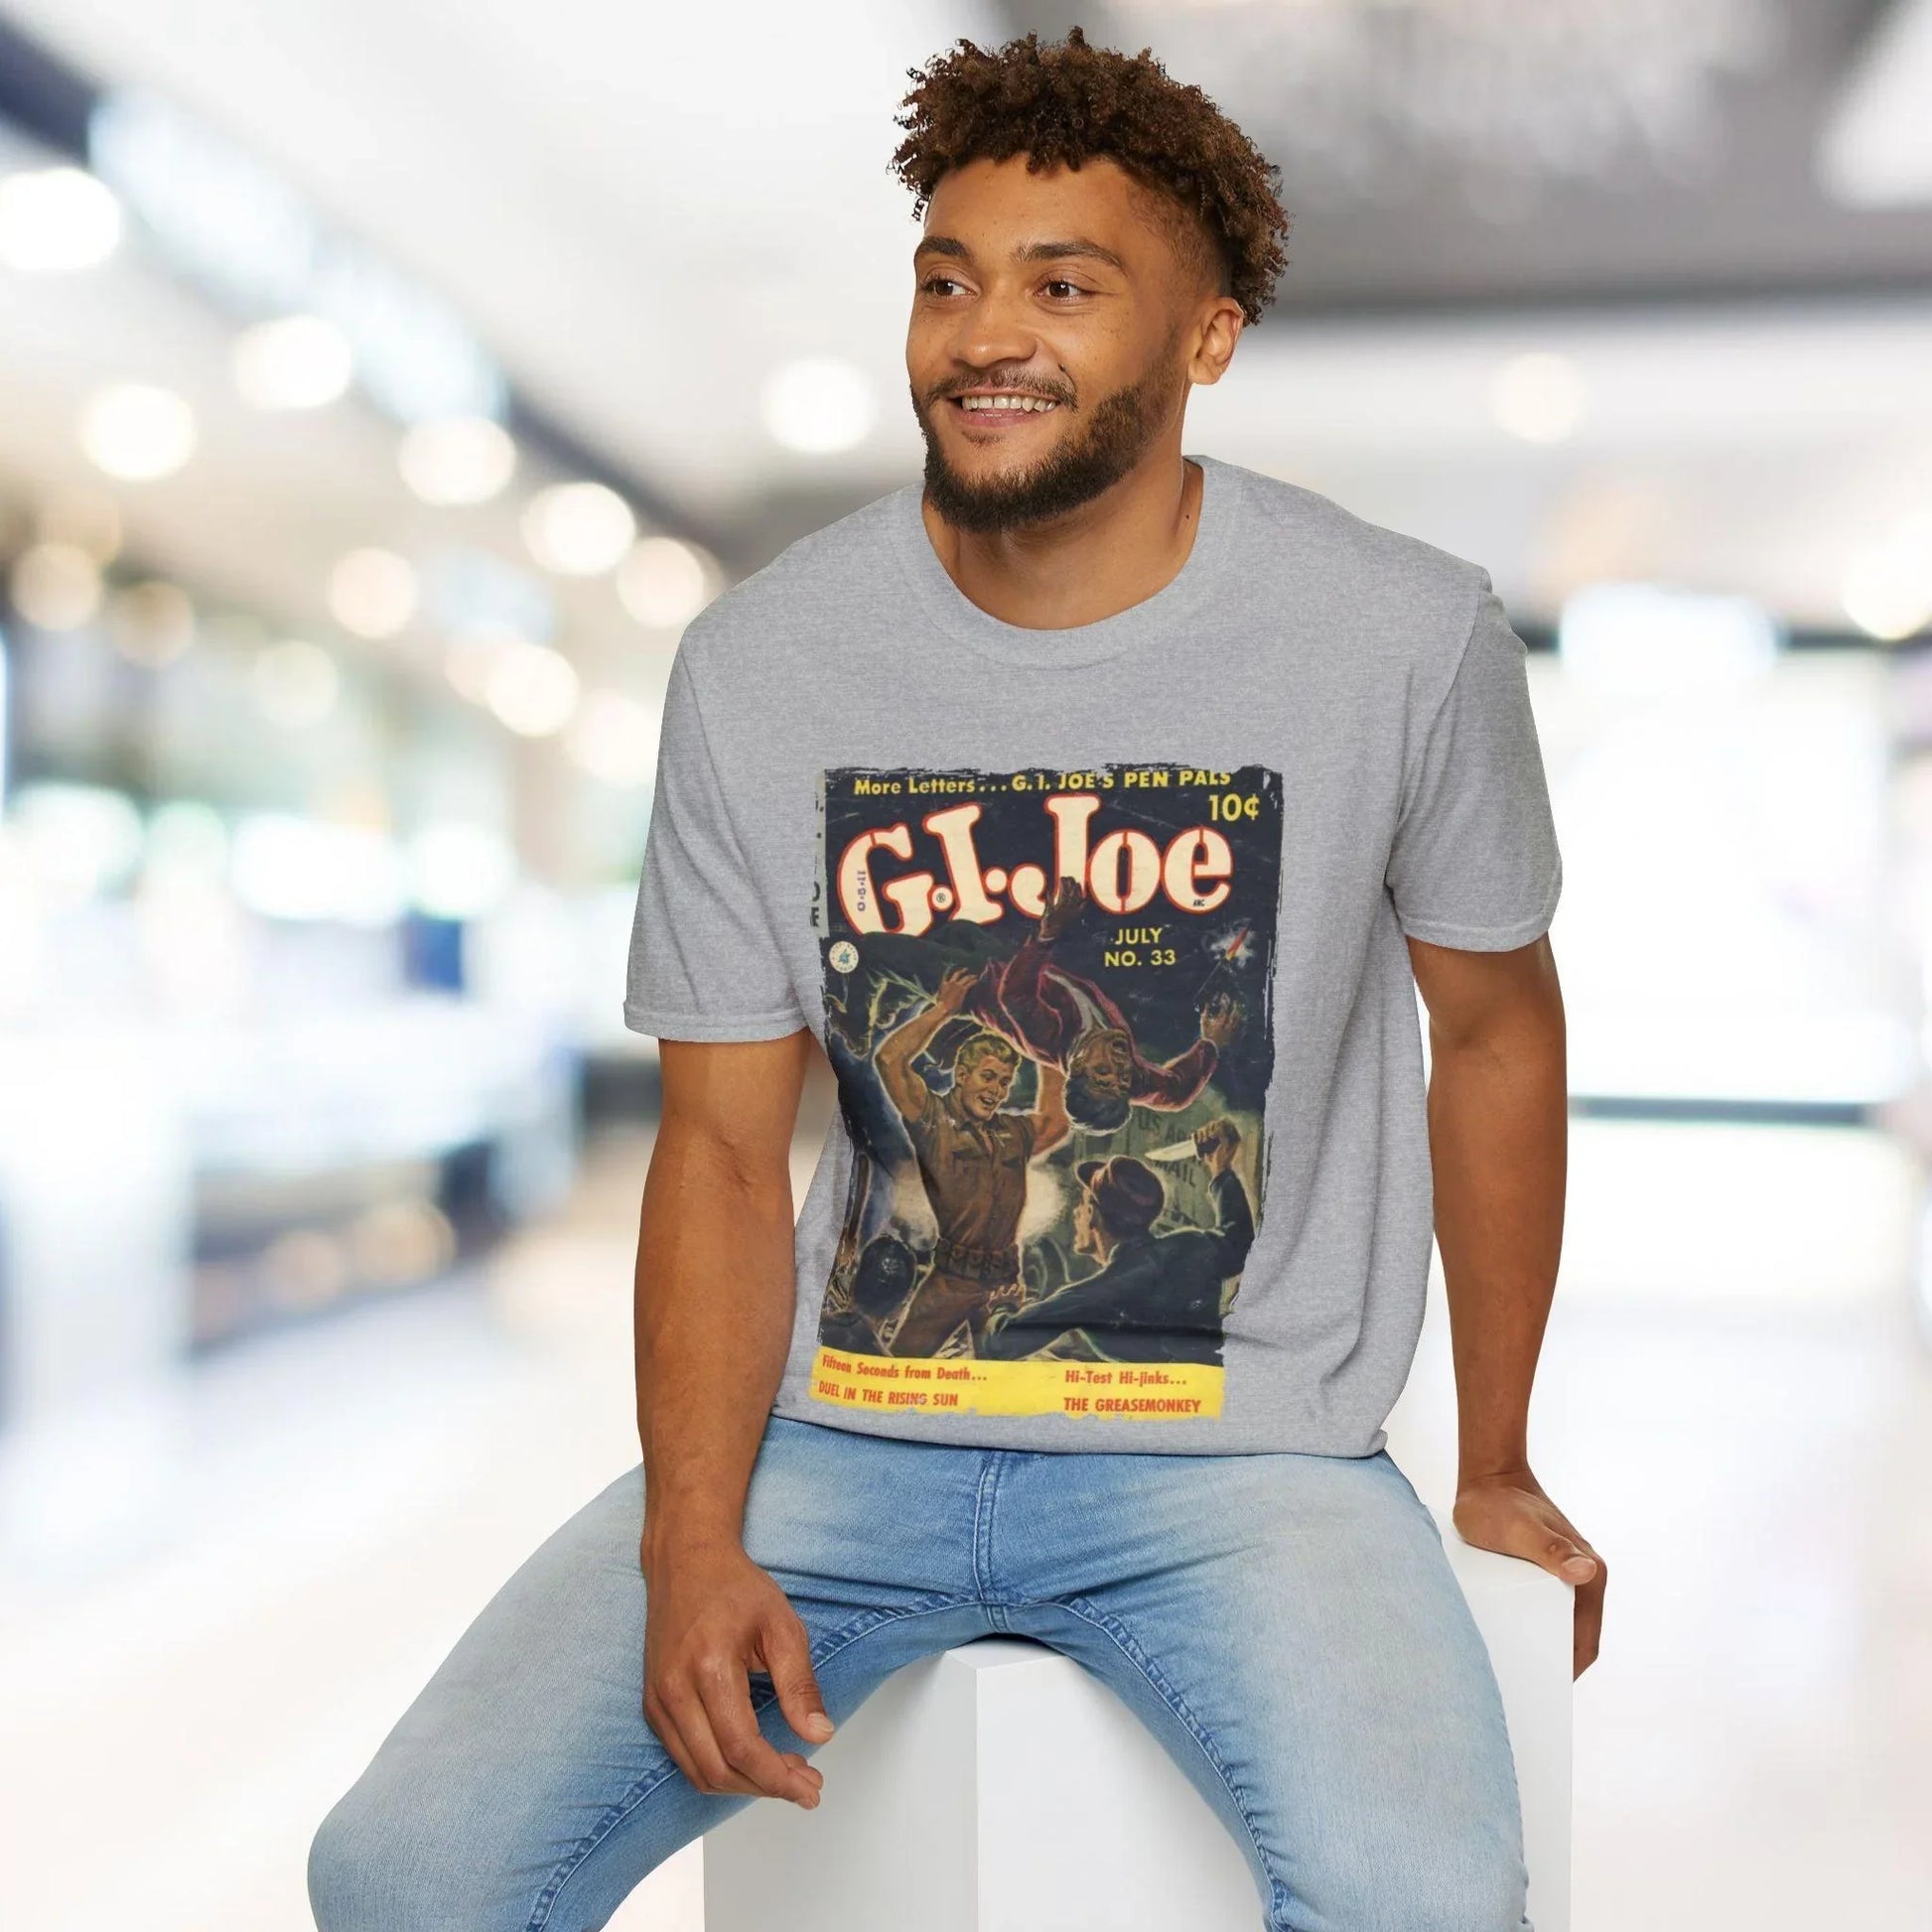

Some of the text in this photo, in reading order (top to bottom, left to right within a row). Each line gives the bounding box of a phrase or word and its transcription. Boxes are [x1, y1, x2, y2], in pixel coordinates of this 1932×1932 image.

[854, 778, 901, 794] More
[1057, 772, 1114, 790] JOE'S
[1124, 771, 1169, 788] PEN
[1179, 769, 1231, 786] PALS
[1208, 793, 1260, 822] 10¢
[1114, 927, 1164, 945] JULY
[1104, 949, 1176, 967] NO. 33
[822, 1354, 852, 1373] Fifteen
[857, 1361, 899, 1378] Seconds
[904, 1365, 931, 1379] from
[1065, 1370, 1113, 1384] Hi-Test
[818, 1380, 959, 1407] DUEL IN THE RISING SUN
[1063, 1397, 1202, 1413] THE GREASEMONKEY
